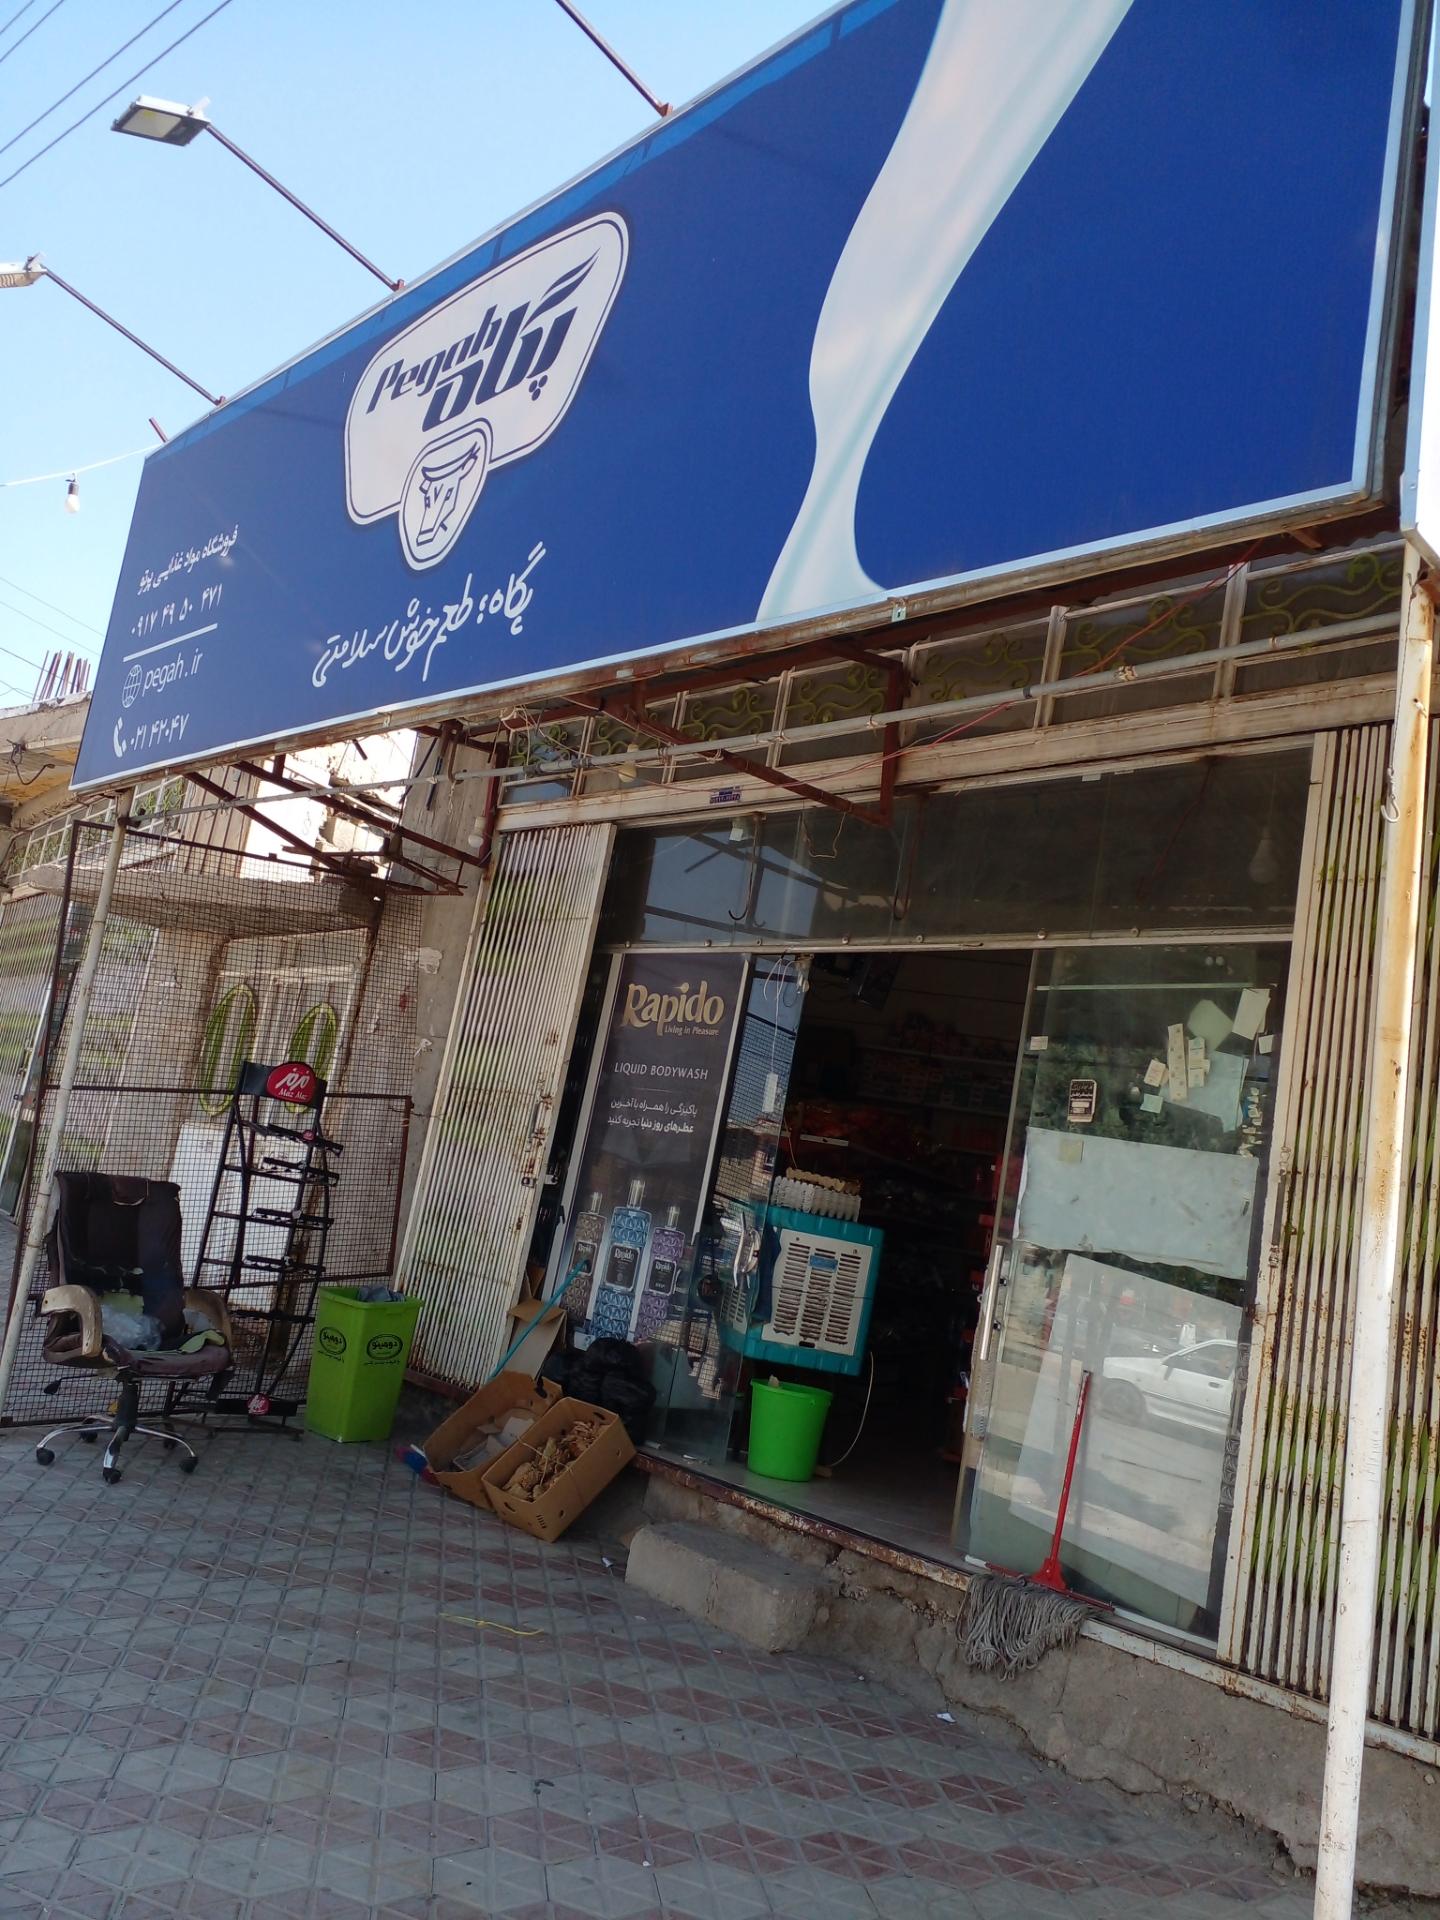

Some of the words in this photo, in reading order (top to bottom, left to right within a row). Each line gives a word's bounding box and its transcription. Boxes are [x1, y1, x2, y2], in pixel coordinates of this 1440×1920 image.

[365, 303, 503, 415] Pegah
[422, 247, 601, 434] پگاه
[183, 546, 201, 574] مواد
[201, 524, 239, 560] فروشگاه
[152, 550, 184, 589] غذایی
[131, 609, 159, 638] ۰۹۱۷
[160, 602, 176, 629] ۴۹
[178, 596, 194, 622] ۵۰
[200, 583, 223, 613] ۴۷۱
[422, 572, 474, 683] طعم
[383, 597, 441, 673] خوش
[141, 647, 204, 698] pegah.ir
[311, 624, 390, 688] سلامتی
[130, 724, 148, 751] ۰۲۱
[148, 712, 190, 748] ۴۲۰۴۷
[621, 979, 726, 1037] Rapido
[614, 1061, 648, 1077] LIQUID
[650, 1064, 709, 1081] BODYWASH
[610, 1097, 634, 1109] آخرین
[640, 1099, 664, 1112] همراه
[663, 1101, 670, 1114] را
[669, 1101, 699, 1118] پاکیزگی
[640, 1116, 653, 1130] دنیا
[663, 1121, 695, 1134] عطرهای
